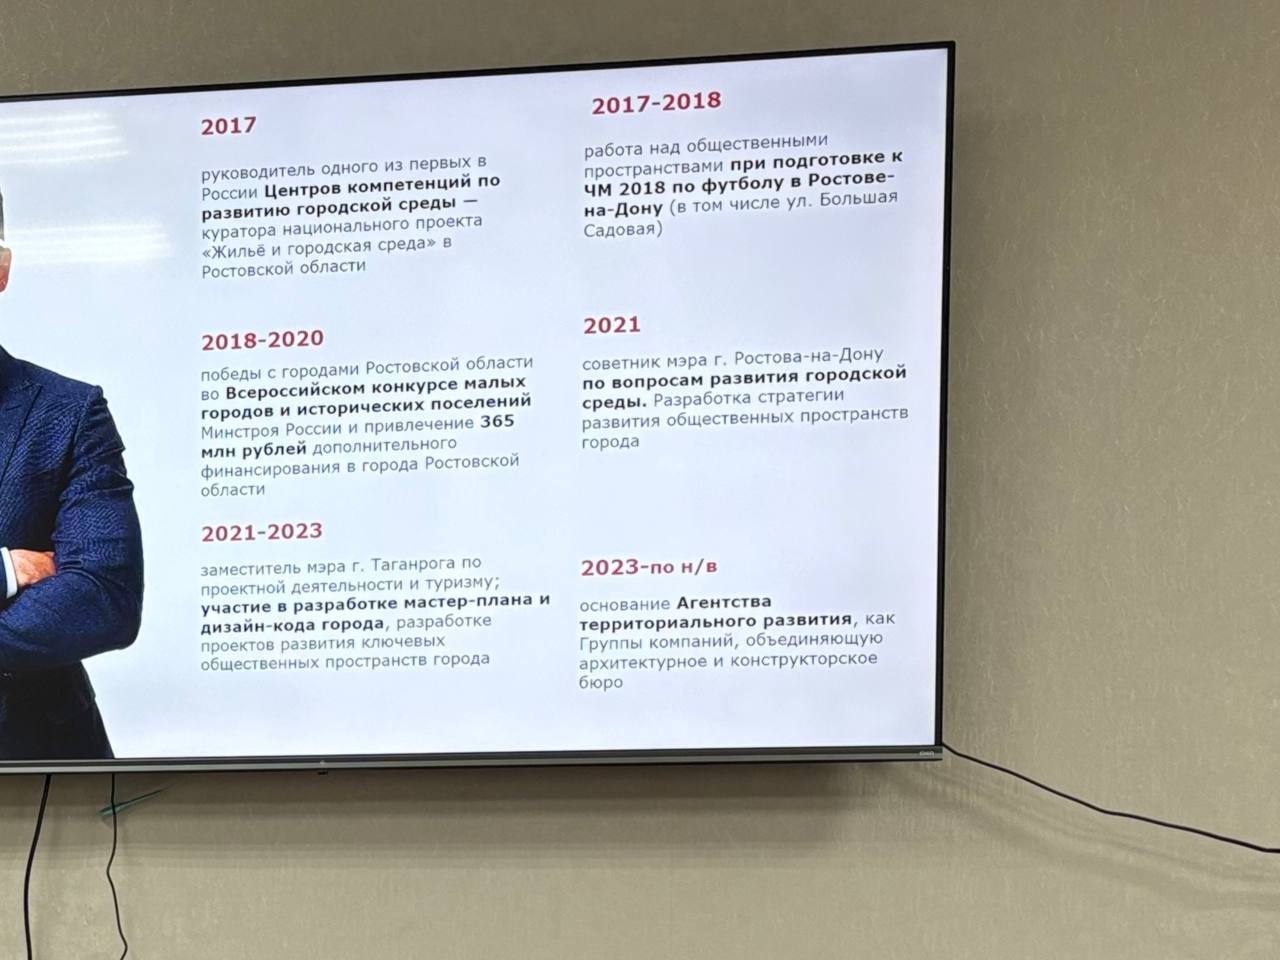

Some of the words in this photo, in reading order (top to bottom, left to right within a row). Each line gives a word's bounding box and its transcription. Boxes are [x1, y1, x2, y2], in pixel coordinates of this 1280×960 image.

[592, 91, 721, 115] 2017-2018
[201, 116, 256, 136] 2017
[584, 142, 643, 161] работа
[650, 142, 681, 156] над
[687, 135, 828, 153] общественными
[201, 165, 315, 184] руководитель
[321, 162, 378, 176] одного
[385, 161, 403, 172] из
[409, 157, 471, 173] первых
[584, 161, 723, 181] пространствами
[730, 159, 766, 174] при
[773, 152, 885, 170] подготовке
[202, 187, 257, 201] России
[264, 184, 342, 200] Центров
[347, 173, 471, 194] компетенций
[478, 176, 501, 187] по
[584, 183, 612, 198] ЧМ
[619, 180, 666, 196] 2018
[672, 182, 696, 194] по
[701, 175, 785, 196] футболу
[808, 172, 895, 187] Ростове-
[202, 206, 291, 224] развитию
[297, 196, 392, 218] городской
[398, 197, 456, 214] среды
[584, 202, 664, 219] на-Дону
[669, 199, 687, 217] (в
[692, 200, 722, 213] том
[729, 198, 780, 211] числе
[786, 196, 812, 211] ул.
[820, 192, 898, 206] Большая
[202, 226, 276, 242] куратора
[283, 219, 410, 236] национального
[416, 216, 482, 232] проекта
[584, 220, 663, 239] Садовая)
[202, 244, 266, 259] «Жильё
[288, 241, 371, 258] городская
[378, 238, 436, 254] среда»
[202, 261, 293, 279] Ростовской
[300, 259, 366, 274] области
[584, 315, 641, 334] 2021
[202, 329, 324, 351] 2018-2020
[201, 366, 261, 382] победы
[282, 365, 359, 381] городами
[366, 357, 459, 375] Ростовской
[466, 355, 533, 370] области
[582, 357, 661, 371] советник
[667, 356, 707, 370] мэра
[714, 355, 726, 366] г.
[735, 347, 884, 365] Ростова-на-Дону
[583, 379, 605, 390] по
[612, 375, 703, 391] вопросам
[710, 372, 799, 389] развития
[806, 363, 907, 385] городской
[201, 390, 219, 401] во
[226, 381, 365, 402] Всероссийском
[372, 380, 458, 395] конкурсе
[464, 377, 526, 390] малых
[201, 407, 274, 422] городов
[297, 400, 425, 418] исторических
[431, 392, 531, 410] поселений
[582, 397, 647, 413] среды.
[654, 390, 751, 409] Разработка
[758, 390, 844, 406] стратегии
[201, 426, 279, 441] Минстроя
[286, 422, 342, 436] России
[365, 418, 474, 436] привлечение
[480, 413, 515, 428] 365
[582, 416, 660, 433] развития
[667, 412, 794, 428] общественных
[800, 408, 909, 425] пространств
[201, 447, 236, 459] млн
[242, 440, 307, 460] рублей
[312, 438, 457, 456] дополнительного
[582, 437, 640, 452] города
[201, 463, 340, 481] финансирования
[347, 462, 356, 473] в
[362, 460, 418, 475] города
[425, 452, 519, 469] Ростовской
[201, 483, 265, 497] области
[202, 522, 322, 542] 2021-2023
[201, 564, 301, 577] заместитель
[307, 562, 345, 576] мэра
[352, 562, 364, 572] г.
[371, 558, 455, 573] Таганрога
[462, 558, 482, 569] по
[581, 558, 674, 576] 2023-по
[681, 558, 717, 576] н/в
[201, 580, 285, 599] проектной
[291, 580, 403, 595] деятельности
[410, 579, 419, 590] и
[425, 577, 499, 592] туризму;
[201, 603, 271, 618] участие
[277, 602, 287, 613] в
[293, 596, 398, 615] разработке
[404, 595, 533, 611] мастер-плана
[539, 594, 550, 605] и
[580, 600, 670, 612] основание
[676, 596, 772, 610] Агентства
[200, 618, 315, 636] дизайн-кода
[322, 619, 390, 634] города,
[397, 613, 492, 632] разработке
[579, 617, 757, 634] территориального
[763, 614, 858, 630] развития,
[866, 614, 895, 625] как
[201, 640, 275, 655] проектов
[281, 638, 355, 654] развития
[362, 636, 445, 648] ключевых
[580, 637, 642, 653] Группы
[649, 633, 739, 650] компаний,
[746, 632, 883, 648] объединяющую
[201, 657, 319, 672] общественных
[325, 656, 427, 671] пространств
[434, 654, 490, 668] города
[579, 657, 707, 673] архитектурное
[714, 657, 723, 667] и
[731, 653, 878, 669] конструкторское
[579, 675, 623, 692] бюро
